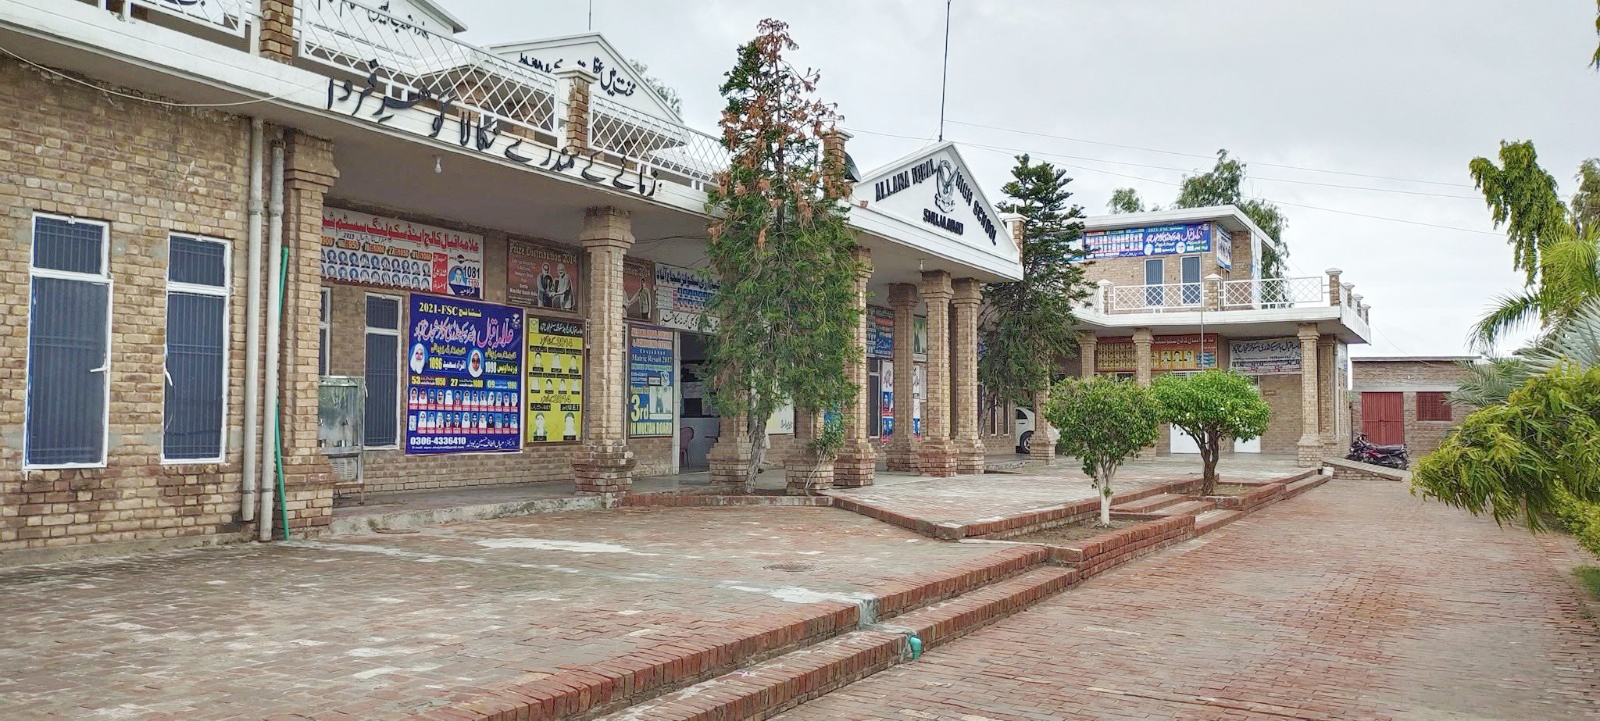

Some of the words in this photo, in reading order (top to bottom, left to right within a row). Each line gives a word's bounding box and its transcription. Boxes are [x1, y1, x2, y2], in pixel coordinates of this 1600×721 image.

[911, 158, 937, 185] IQBAL
[955, 171, 973, 206] HIGH
[972, 200, 996, 246] SCHOOL
[463, 265, 480, 279] 1081
[450, 378, 459, 387] 27
[630, 394, 649, 422] 3rd
[410, 436, 466, 446] 0306-4336410
